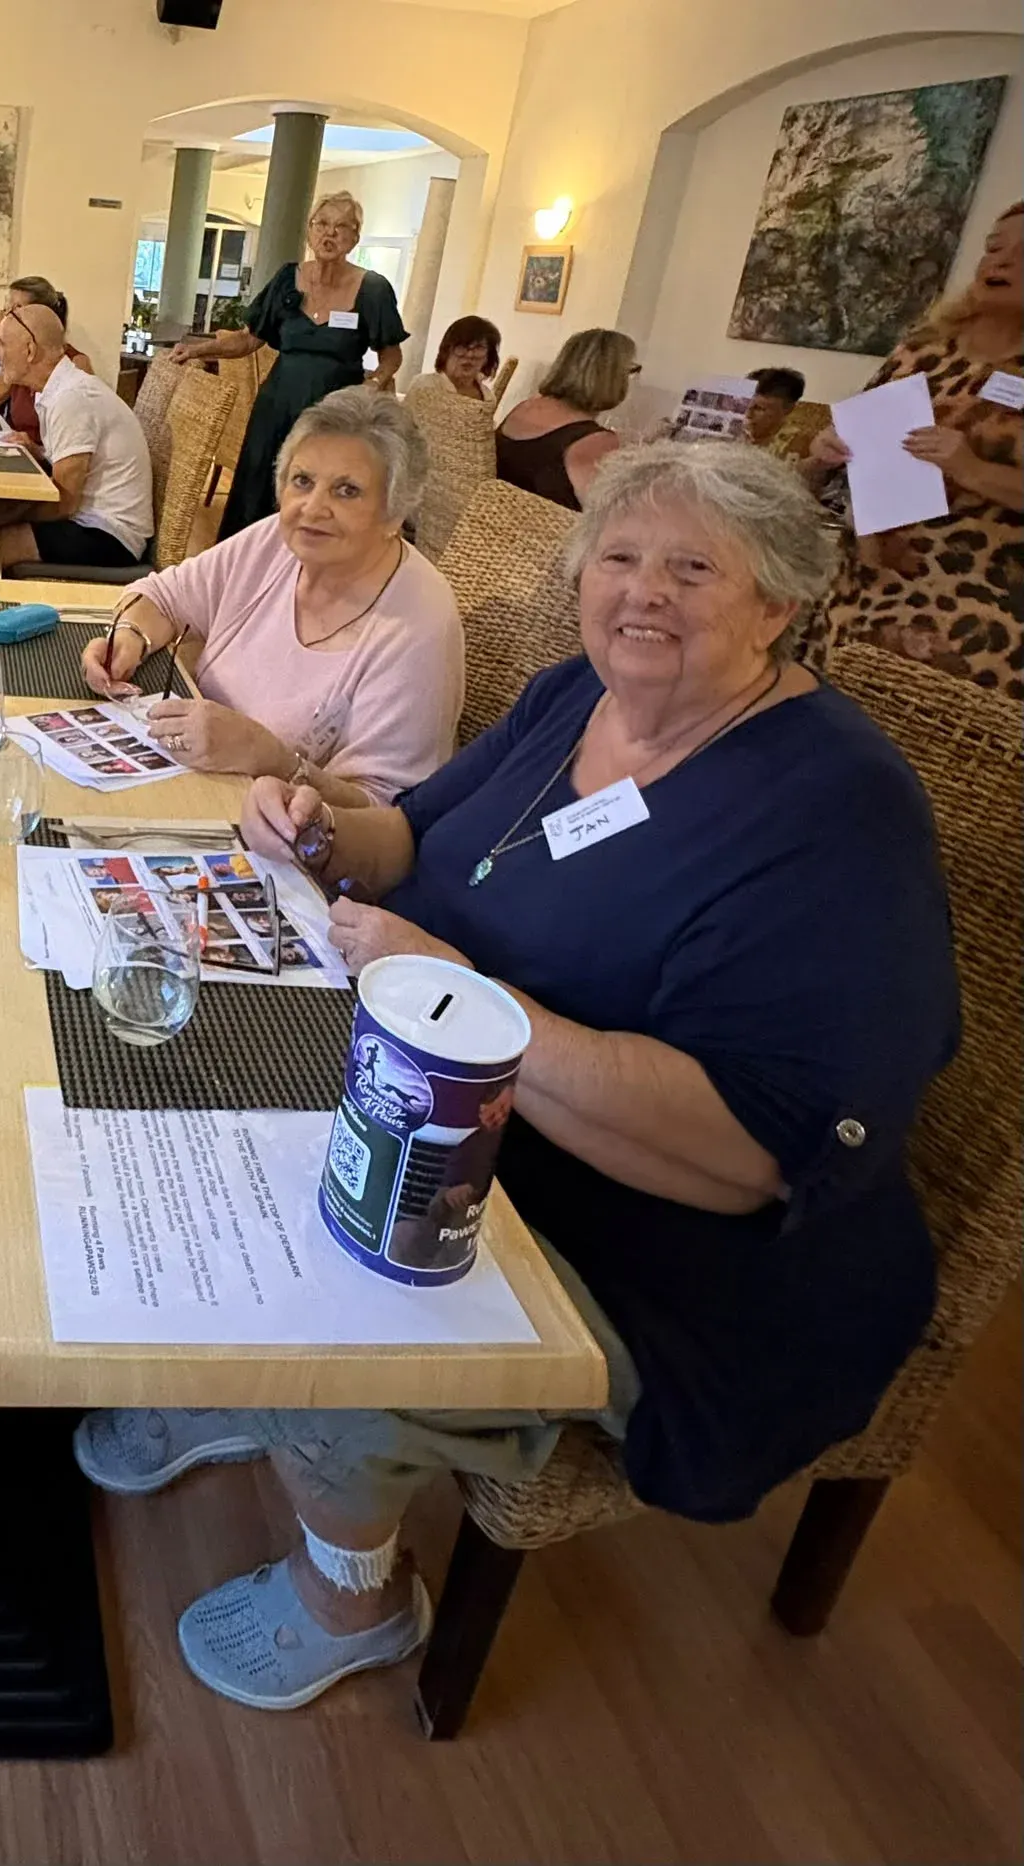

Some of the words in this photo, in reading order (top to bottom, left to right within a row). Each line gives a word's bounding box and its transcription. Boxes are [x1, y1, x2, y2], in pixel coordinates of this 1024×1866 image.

[568, 813, 610, 842] JAN
[355, 1071, 407, 1117] Running
[361, 1097, 372, 1110] 4
[371, 1102, 409, 1129] Paws
[236, 1140, 246, 1153] THE
[241, 1155, 254, 1180] SOUTH
[250, 1182, 260, 1193] OF
[253, 1163, 267, 1183] FROM
[262, 1187, 272, 1201] THE
[274, 1221, 285, 1232] OF
